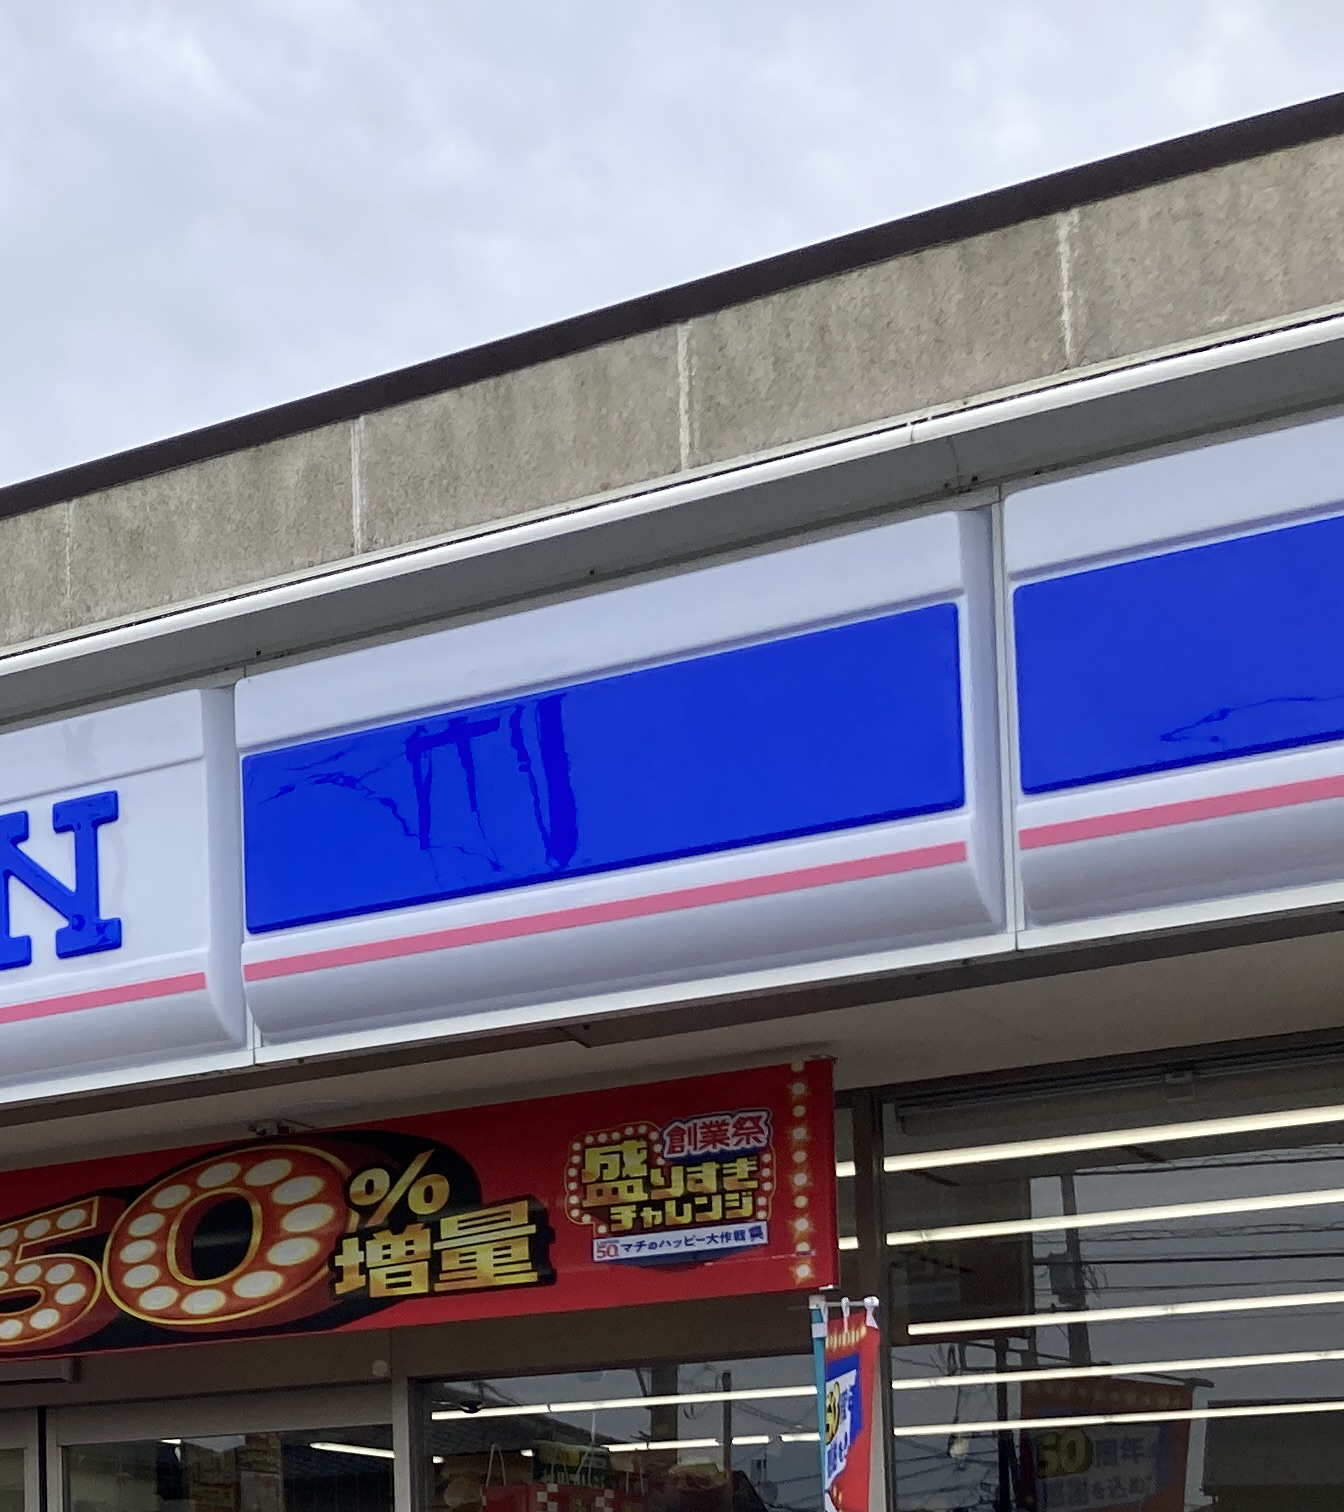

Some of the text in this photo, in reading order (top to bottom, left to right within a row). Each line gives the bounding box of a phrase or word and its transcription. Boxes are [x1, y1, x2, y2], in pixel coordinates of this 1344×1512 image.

[665, 1115, 765, 1154] 創業祭
[581, 1137, 759, 1208] 盛りすぎ
[610, 1191, 754, 1232] チャレンジ
[333, 1203, 548, 1299] 増量
